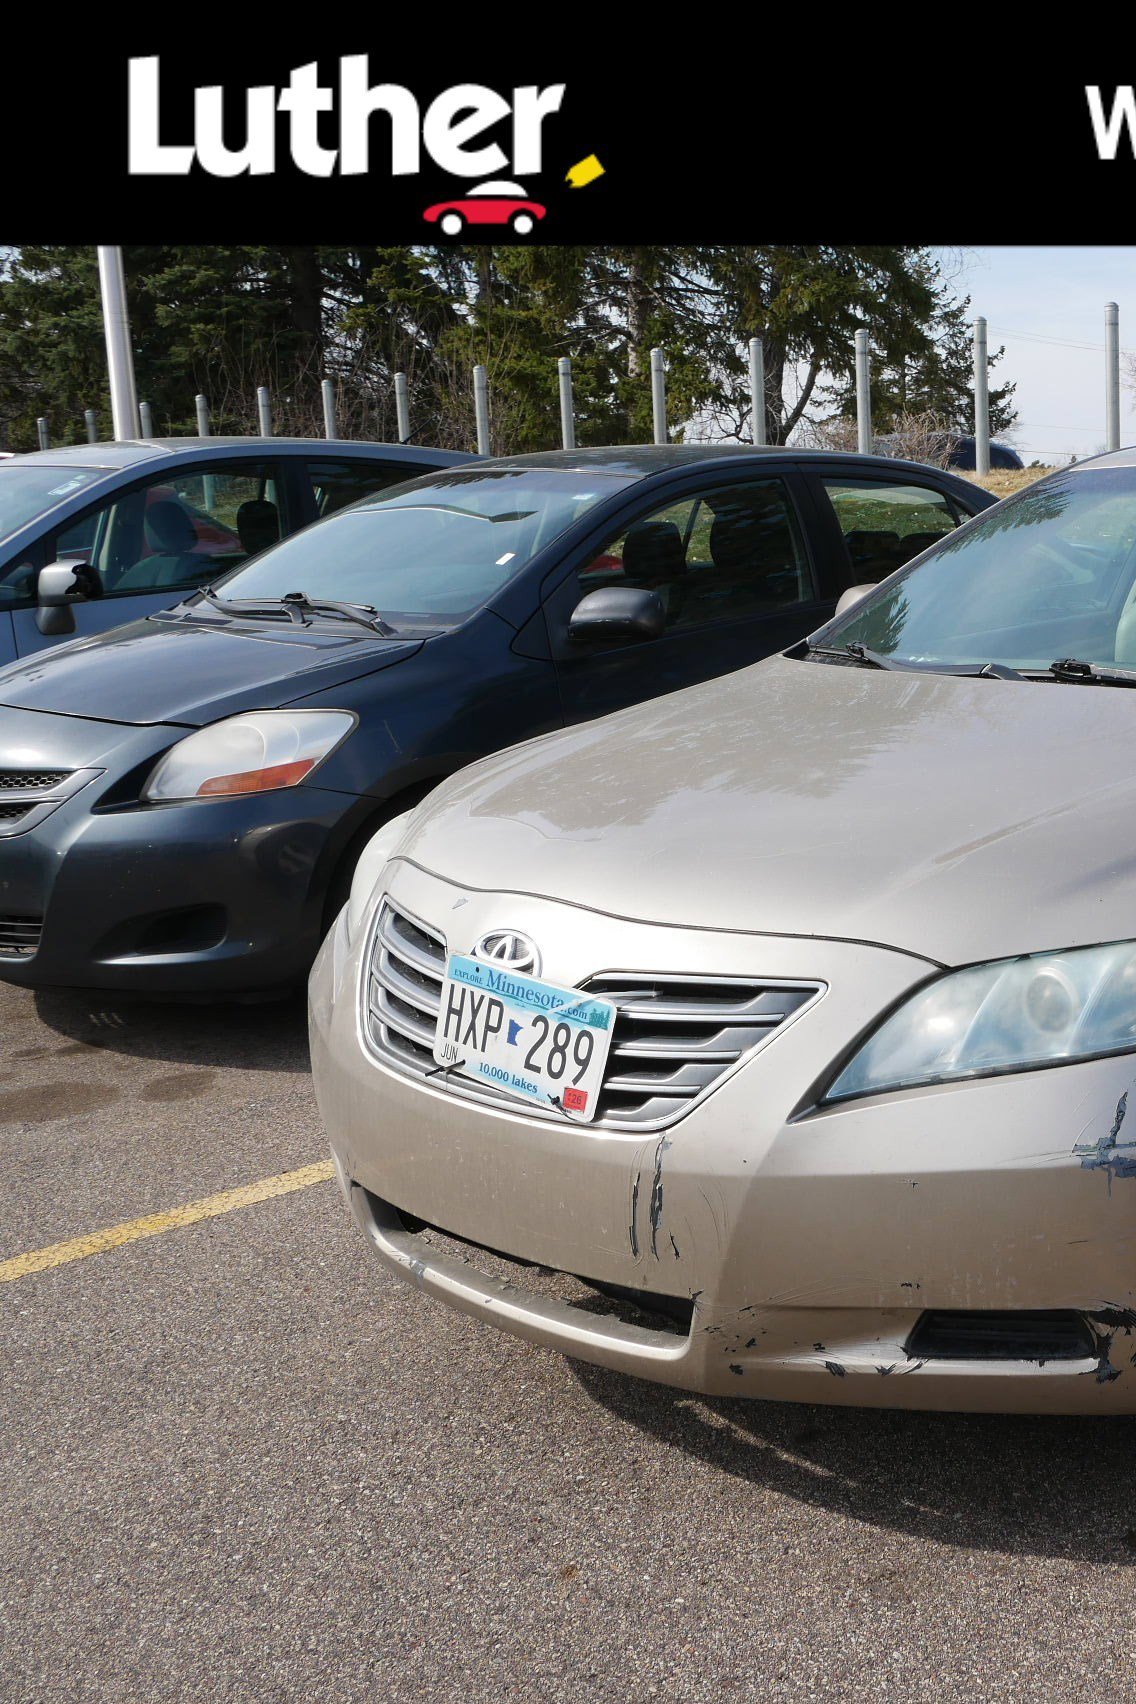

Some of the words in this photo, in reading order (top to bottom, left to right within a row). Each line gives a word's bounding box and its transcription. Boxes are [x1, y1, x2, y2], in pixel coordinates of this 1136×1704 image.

[453, 968, 484, 985] EXPLORE
[443, 983, 505, 1053] HXP
[523, 1014, 595, 1086] 289
[440, 1043, 460, 1062] JUN
[478, 1061, 510, 1083] 10,000
[511, 1072, 539, 1094] lakes
